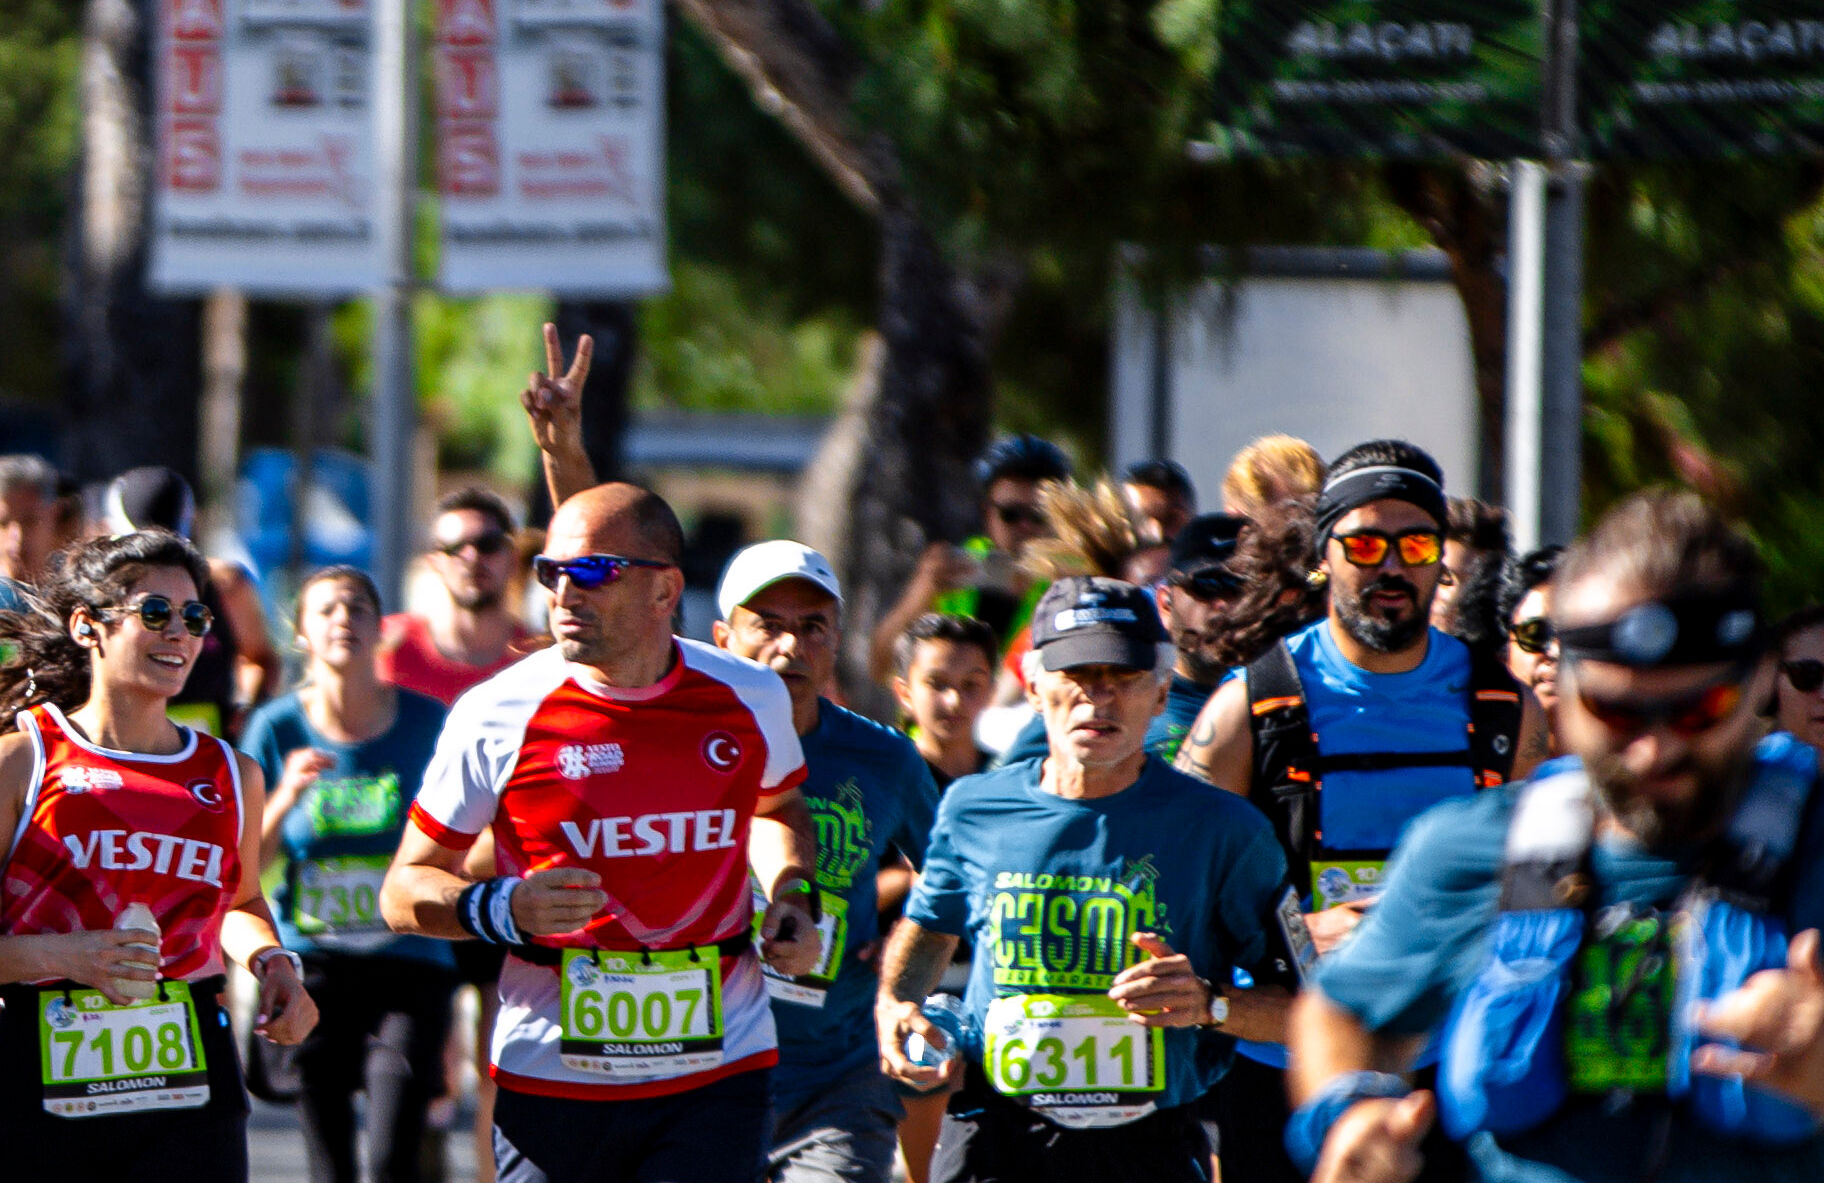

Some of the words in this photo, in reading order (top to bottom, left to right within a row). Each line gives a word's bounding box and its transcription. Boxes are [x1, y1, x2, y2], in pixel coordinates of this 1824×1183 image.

[560, 808, 737, 859] VESTEL
[62, 829, 224, 888] VESTEL
[303, 884, 376, 926] 730
[994, 871, 1113, 894] SALOMON
[574, 989, 703, 1037] 6007
[54, 1022, 187, 1077] 7108
[602, 1042, 684, 1055] SALOMON
[1000, 1035, 1134, 1089] 6311
[86, 1076, 167, 1094] SALOMON
[1031, 1092, 1119, 1106] SALOMON
